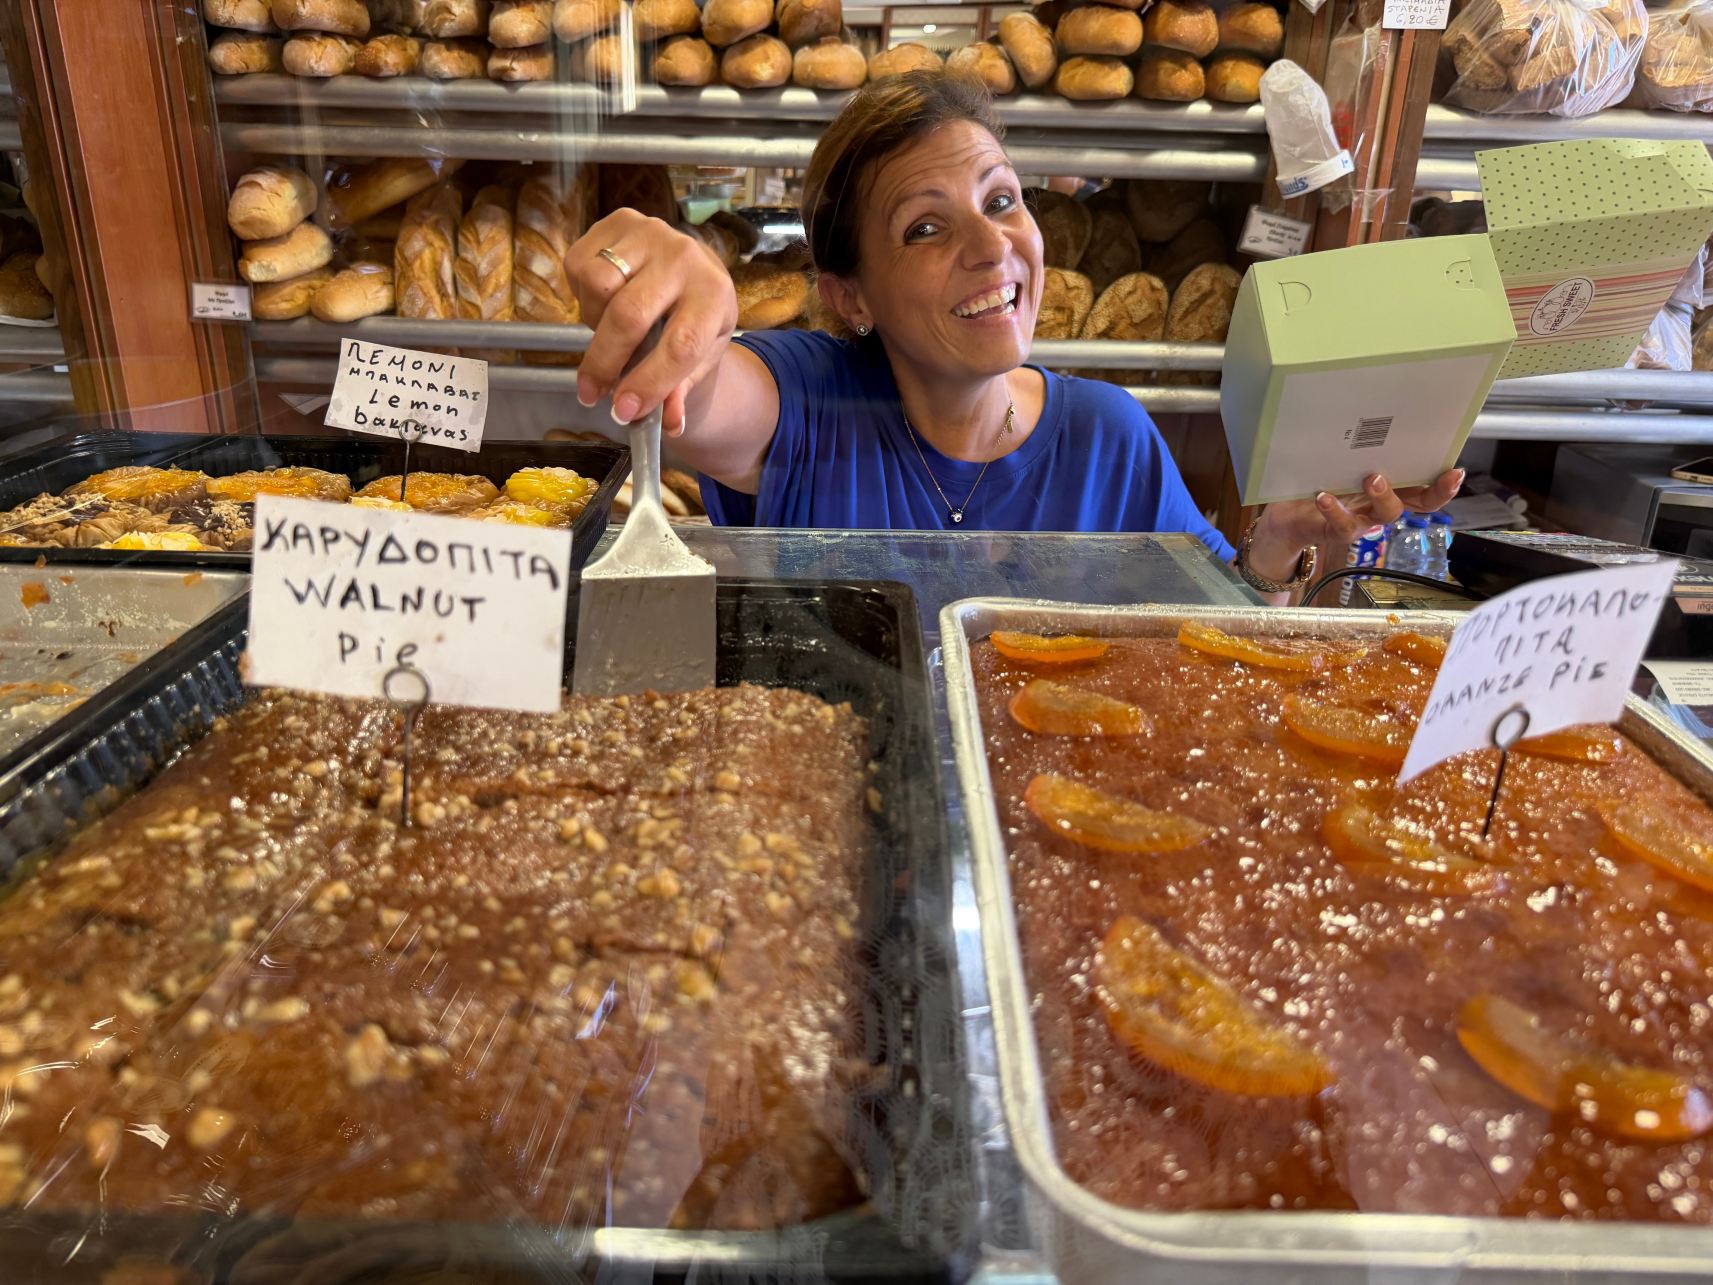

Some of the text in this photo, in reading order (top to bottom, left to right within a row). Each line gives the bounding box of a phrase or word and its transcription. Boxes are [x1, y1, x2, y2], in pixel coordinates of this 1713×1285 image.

[1549, 308, 1568, 332] FRESH
[1563, 282, 1583, 308] SWEET
[369, 389, 459, 416] Lemon
[284, 574, 487, 622] WALNUT
[1495, 625, 1575, 665] ΠΙΤΑ
